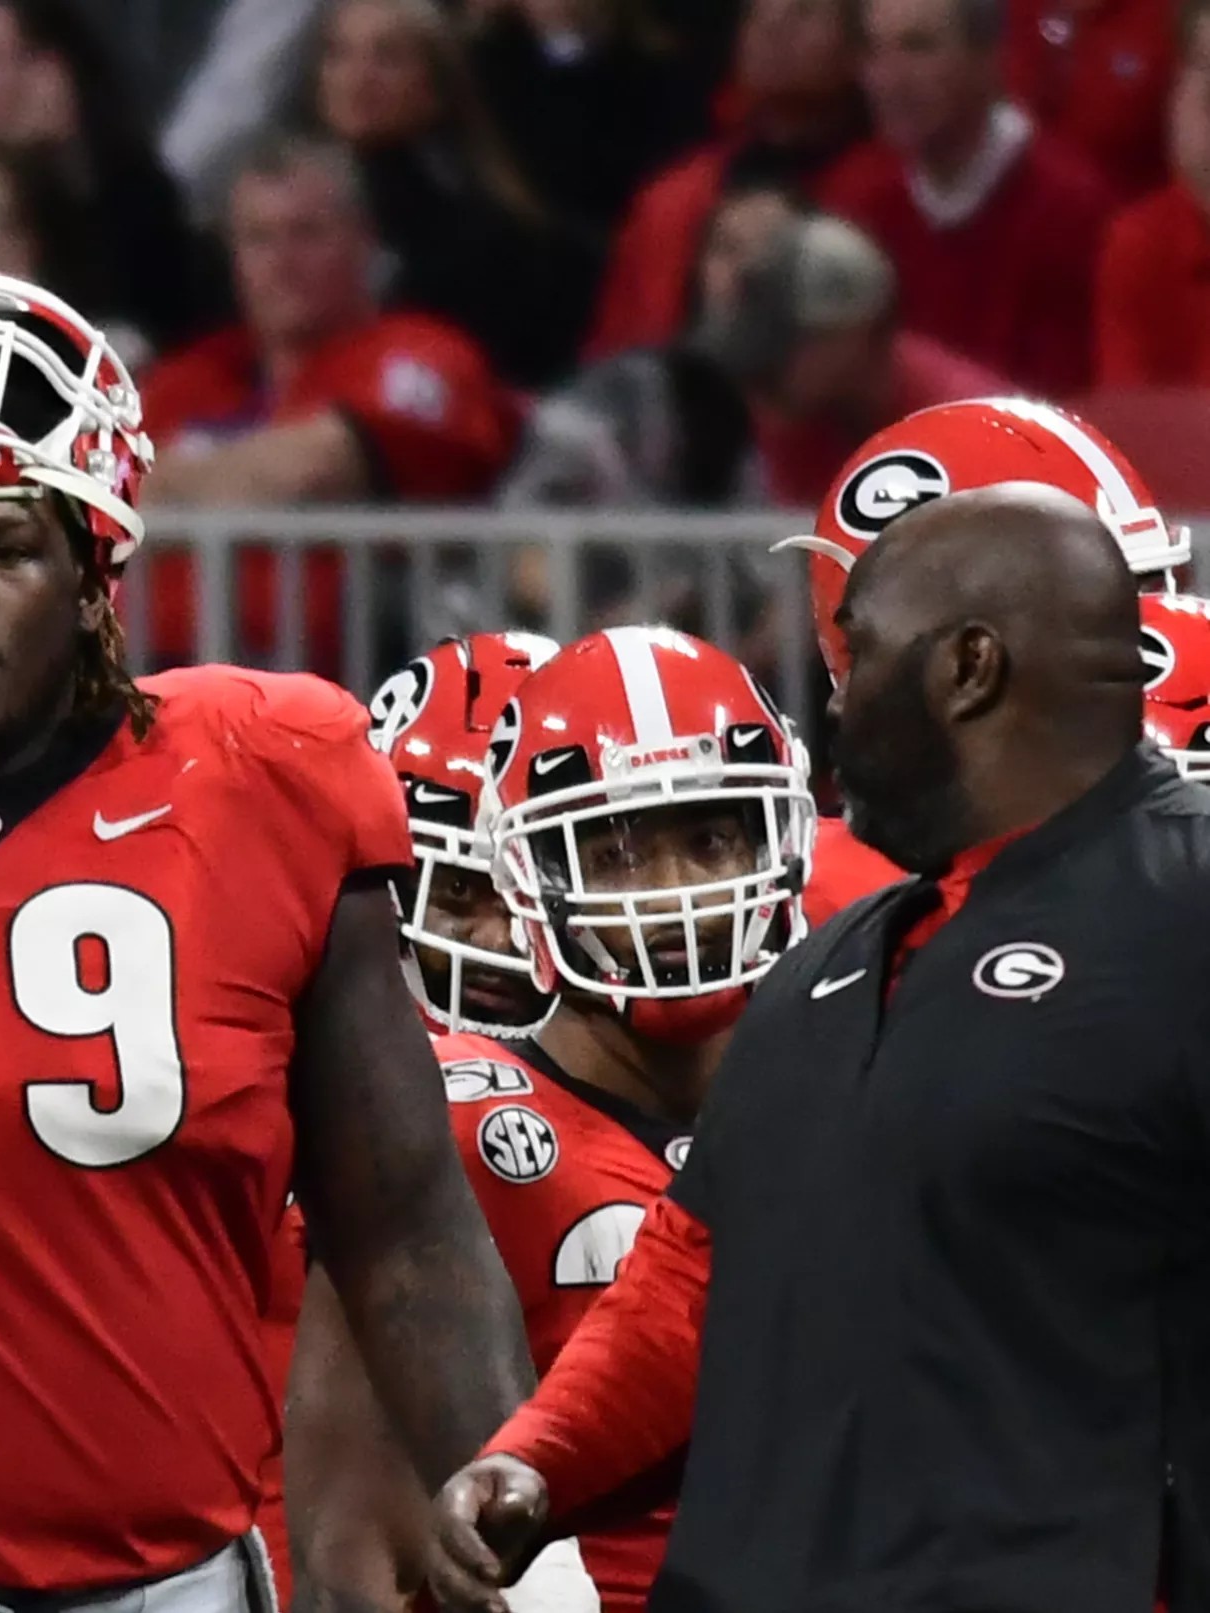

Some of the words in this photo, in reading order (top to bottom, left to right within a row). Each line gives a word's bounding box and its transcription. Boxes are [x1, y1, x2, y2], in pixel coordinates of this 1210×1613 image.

[848, 459, 948, 524] G
[987, 948, 1063, 990] G
[441, 1059, 532, 1101] 50
[482, 1108, 555, 1179] SEC
